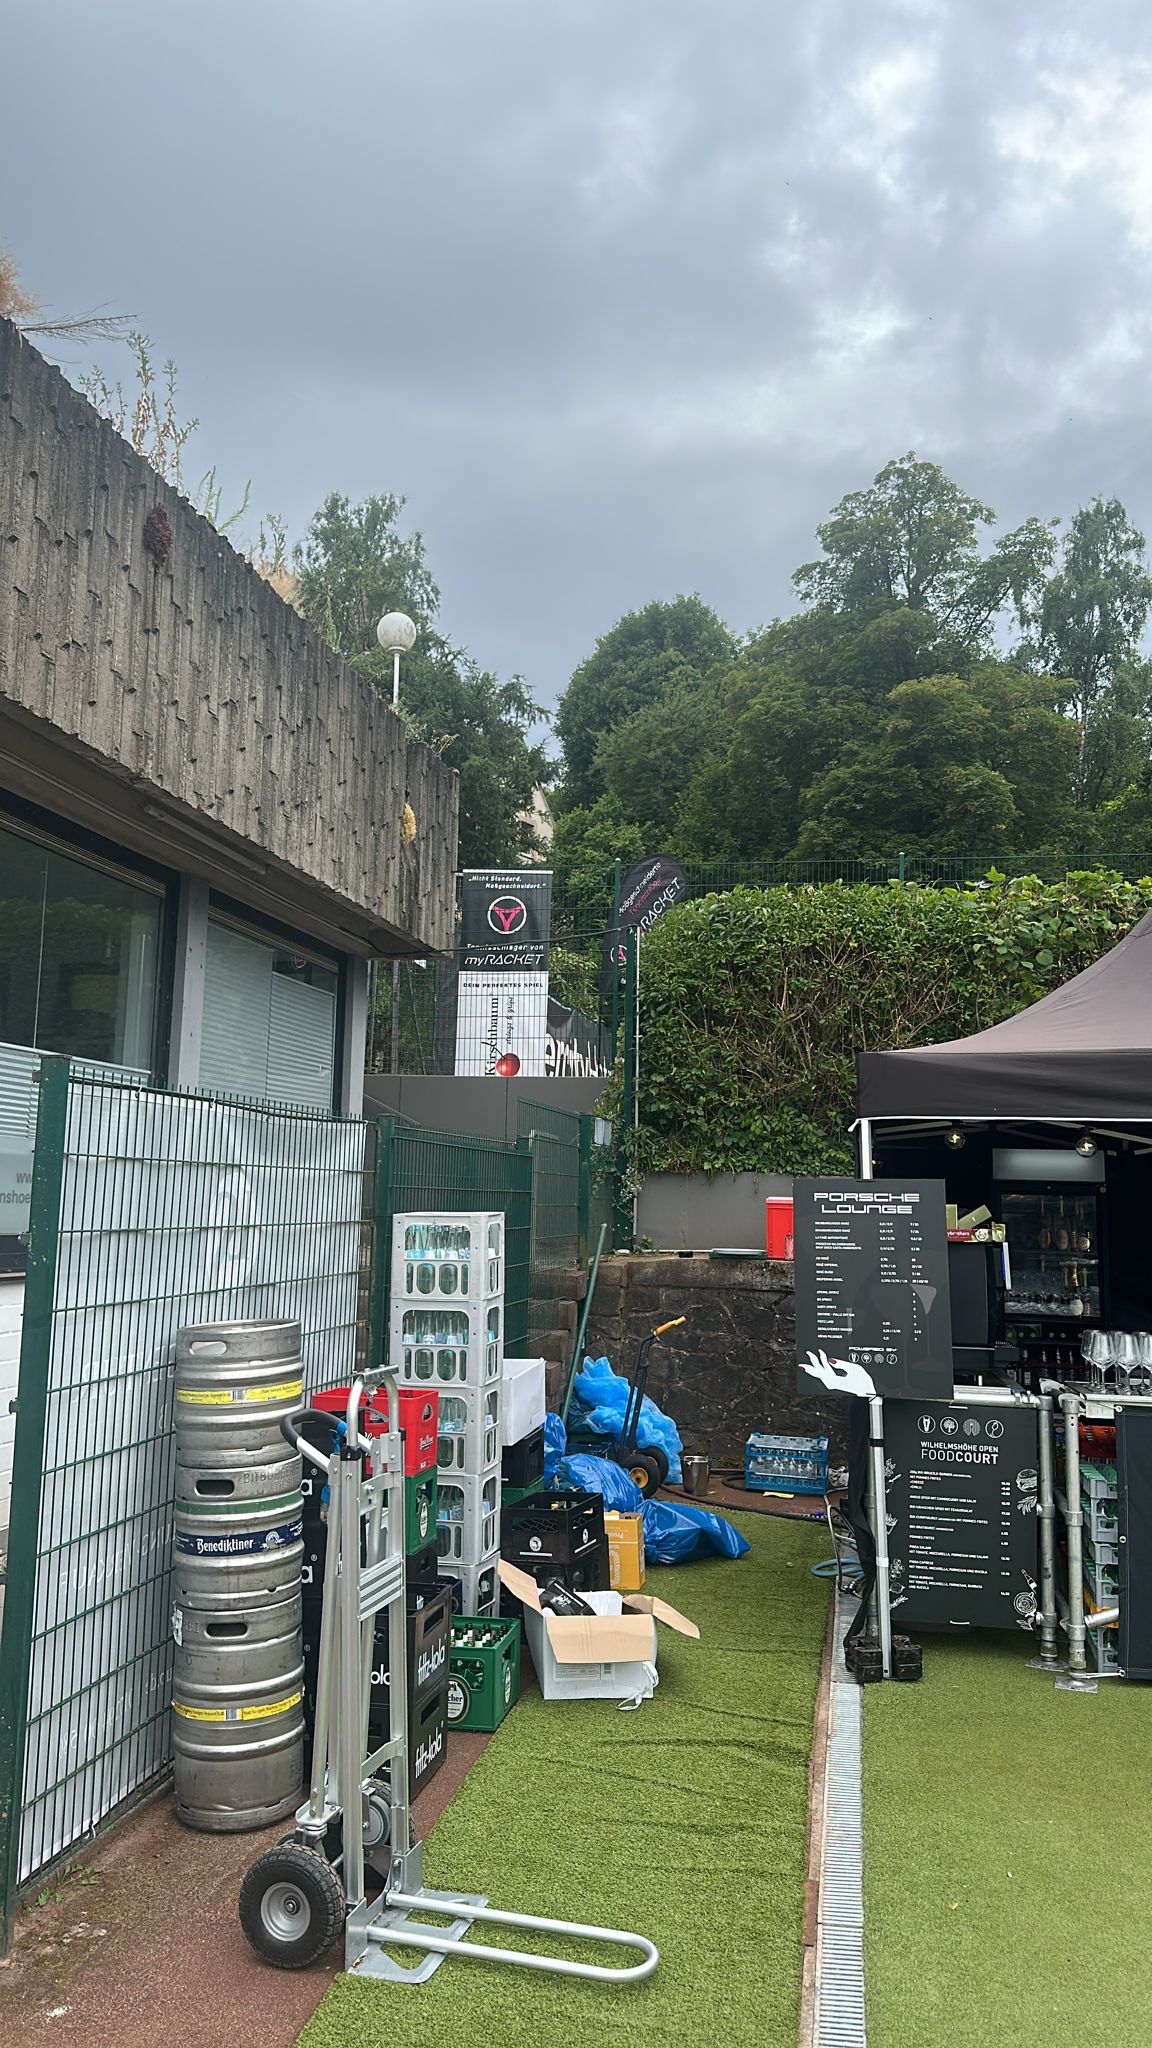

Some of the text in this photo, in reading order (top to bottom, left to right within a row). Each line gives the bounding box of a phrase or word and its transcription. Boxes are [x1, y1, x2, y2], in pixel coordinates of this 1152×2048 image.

[464, 954, 544, 967] myRACKET
[485, 995, 498, 1076] Kirschbaum
[814, 1193, 920, 1202] PORSCHE
[822, 1205, 913, 1214] LOUNGE
[921, 1441, 977, 1452] WILHELMSHÖHE
[921, 1449, 999, 1465] FOODCOURT
[196, 1538, 254, 1554] Benediktiner
[417, 1638, 446, 1686] fritz-kola
[415, 1727, 443, 1780] fritz-kola
